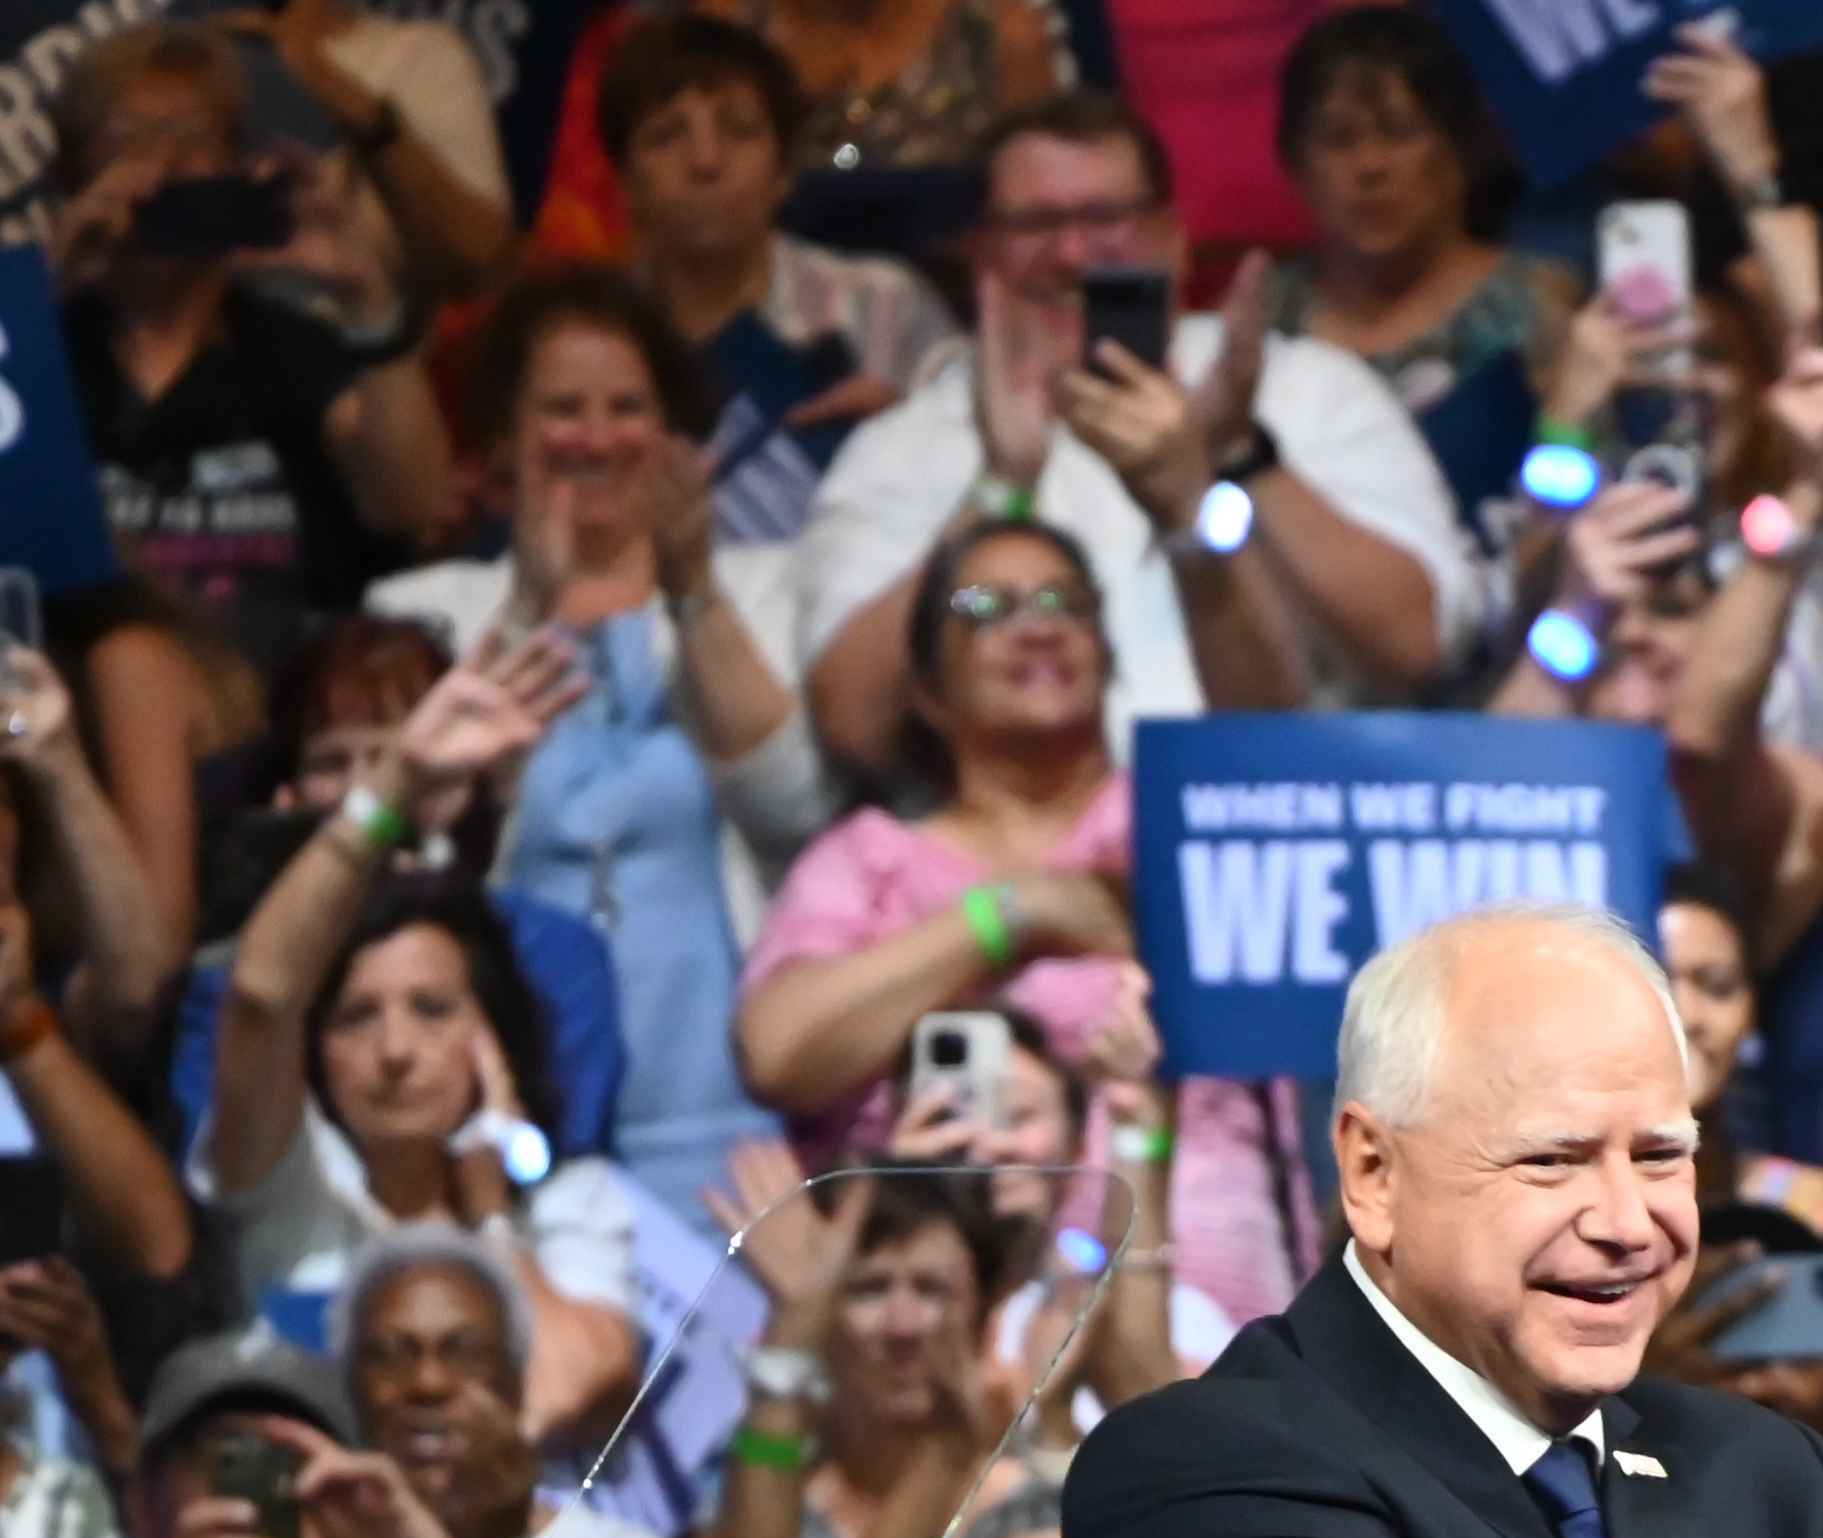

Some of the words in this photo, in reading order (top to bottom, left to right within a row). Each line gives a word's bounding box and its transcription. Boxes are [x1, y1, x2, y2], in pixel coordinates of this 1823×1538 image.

[1181, 783, 1344, 831] WHEN
[1350, 783, 1436, 831] WE
[1444, 784, 1606, 834] FIGHT
[1177, 839, 1350, 984] WE
